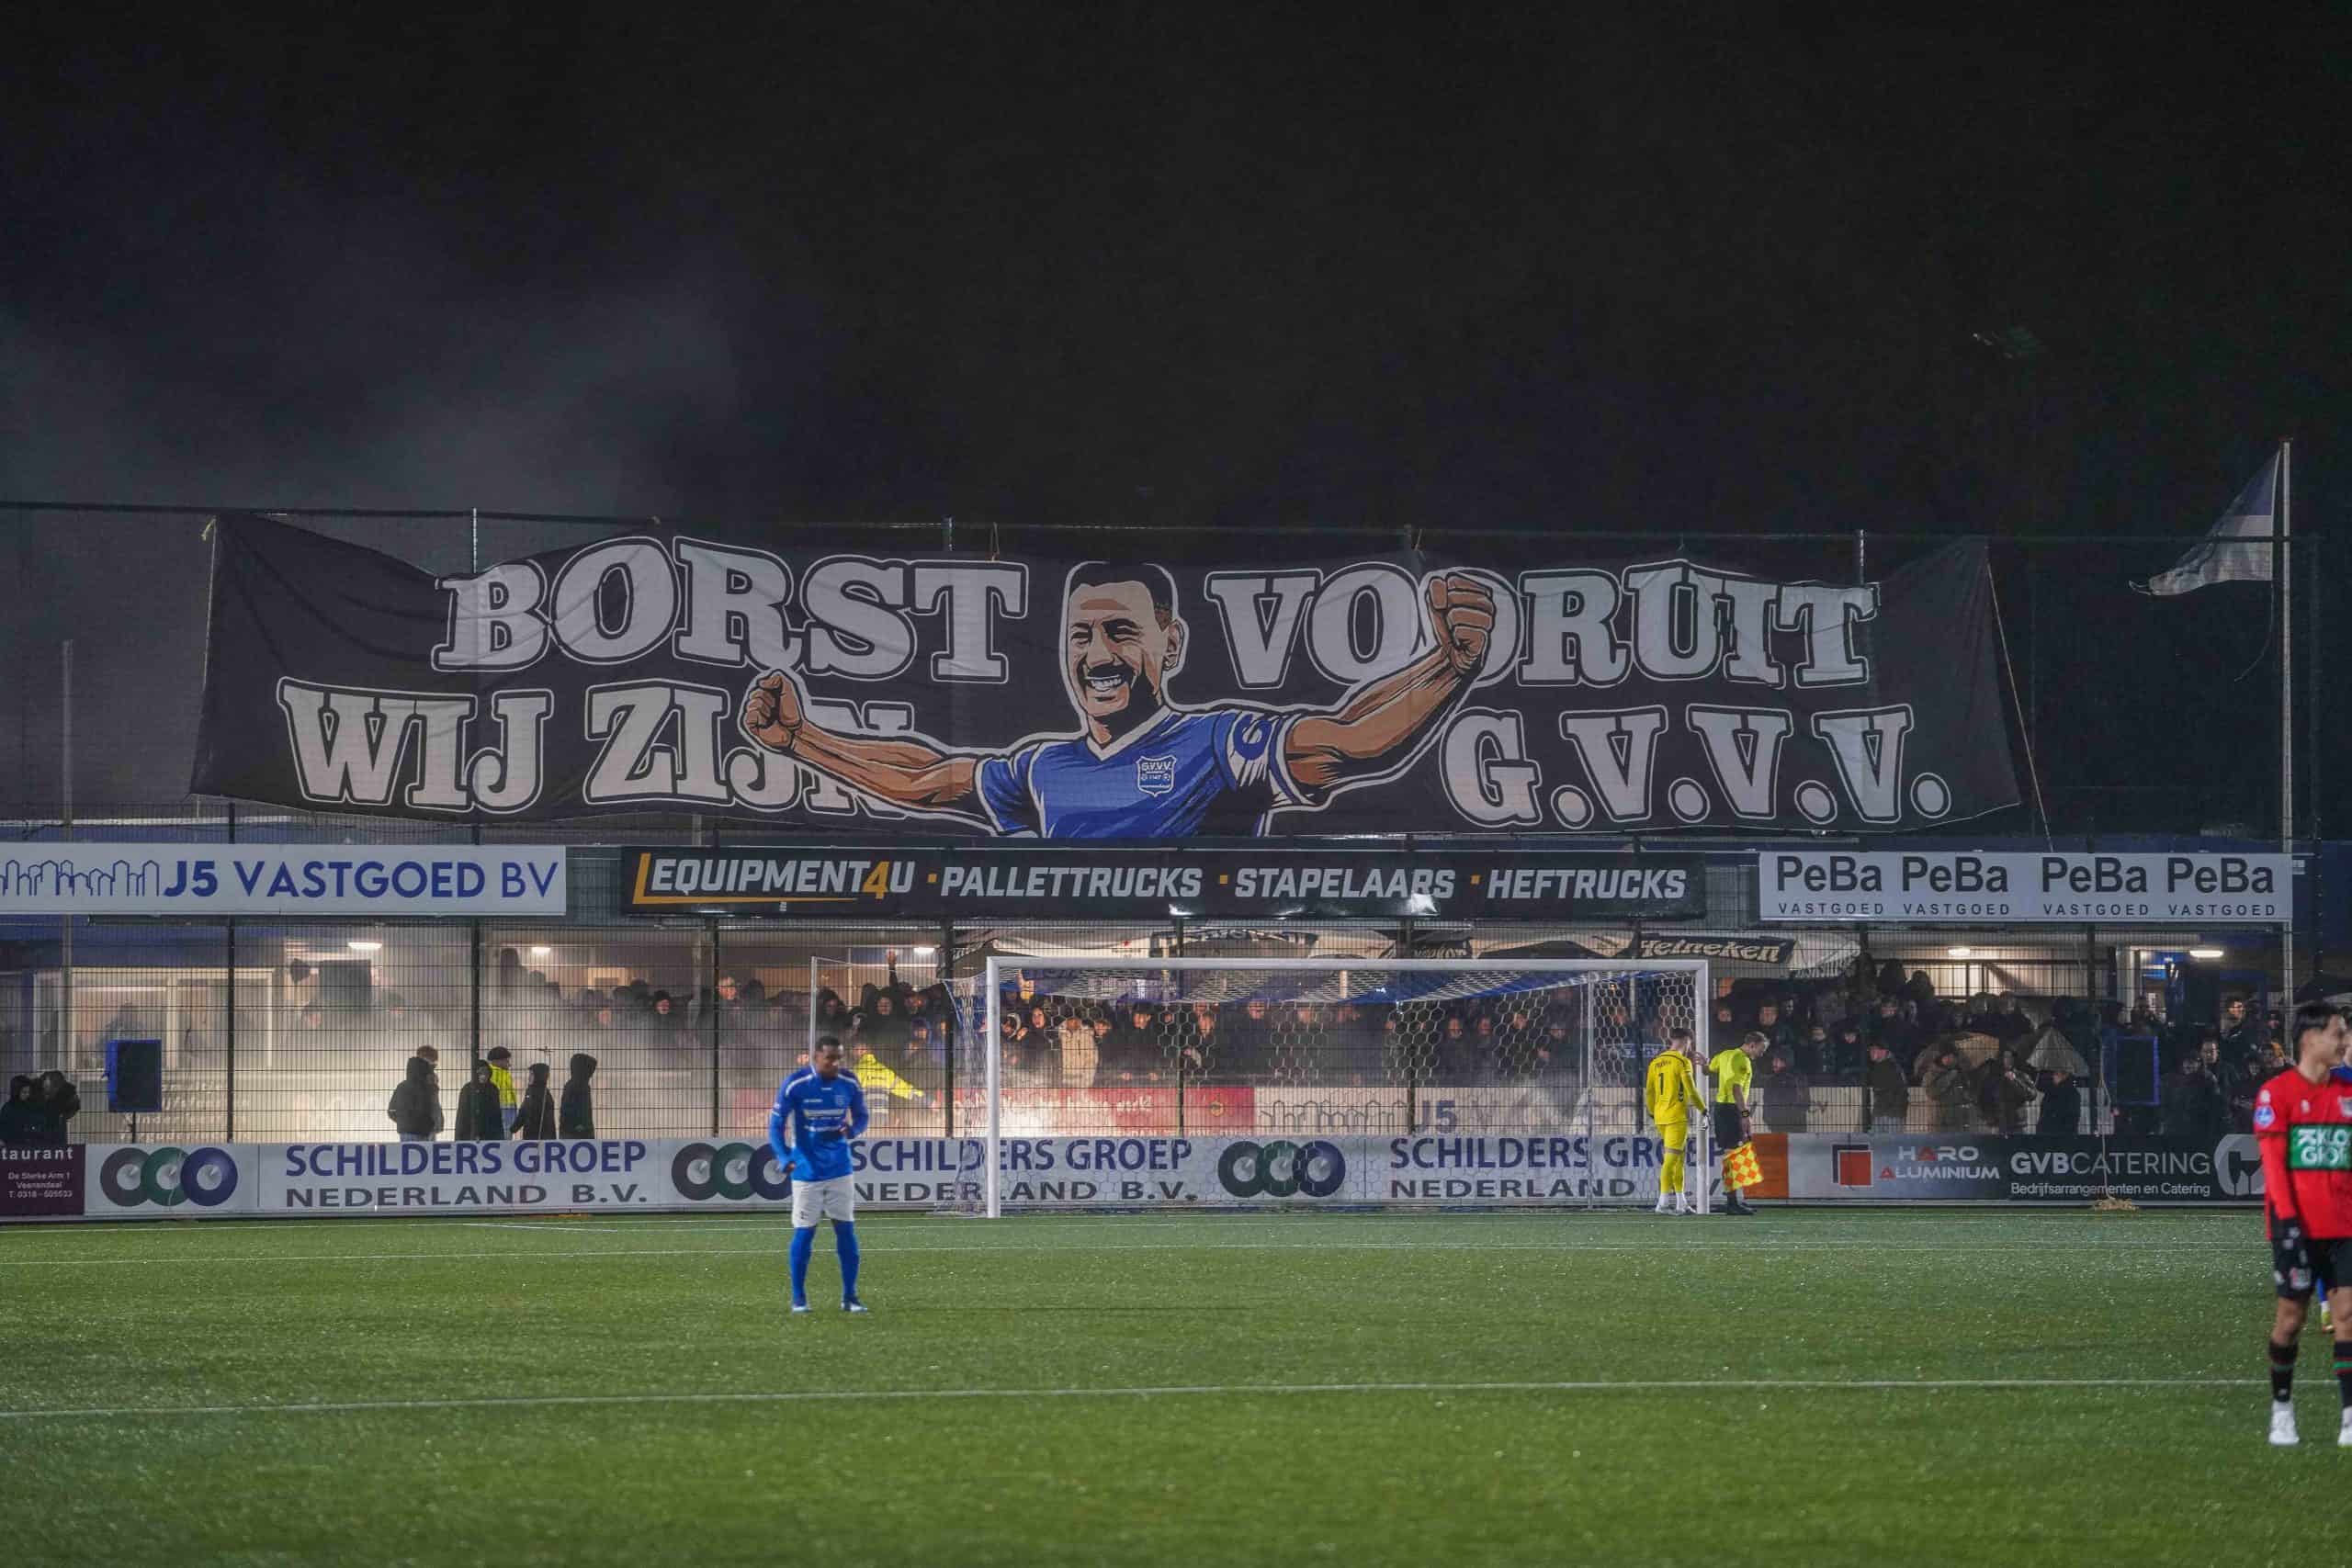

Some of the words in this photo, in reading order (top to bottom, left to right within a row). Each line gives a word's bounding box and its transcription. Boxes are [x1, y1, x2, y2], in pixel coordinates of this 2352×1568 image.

[431, 536, 1029, 684] BORST
[277, 676, 553, 812] WIJ
[1440, 705, 1951, 829] G.V.V.V.
[164, 861, 218, 897] J5
[234, 860, 486, 897] VASTGOED
[502, 862, 559, 897] BV
[650, 859, 916, 900] EQUIPMENT4U
[941, 866, 1203, 897] PALLETTRUCKS
[1234, 867, 1456, 898] STAPELAARS
[1487, 869, 1687, 899] HEFTRUCKS
[1776, 855, 1883, 893] PeBa
[1902, 855, 2009, 893] PeBa
[2041, 856, 2148, 894] PeBa
[2166, 857, 2275, 894] PeBa
[1778, 903, 1884, 915] VASTGOED
[1904, 903, 2010, 915] VASTGOED
[2043, 903, 2150, 916] VASTGOED
[2168, 904, 2276, 916] VASTGOED
[1641, 938, 1780, 963] Heineken
[1658, 1072, 1664, 1096] 1
[1, 1146, 74, 1160] taurant
[287, 1142, 501, 1177] SCHILDERS
[514, 1141, 646, 1173] GROEP
[1066, 1139, 1192, 1170] GROEP
[1390, 1137, 1589, 1168] SCHILDERS
[1603, 1136, 1725, 1168] GREP
[1898, 1146, 1979, 1162] HARO
[2010, 1151, 2211, 1176] GVBCATERING
[1879, 1166, 2000, 1179] ALUMINIUM
[287, 1184, 548, 1207] NEDERLAND
[572, 1184, 647, 1203] B.V.
[854, 1181, 1098, 1201] NEDERAND
[1121, 1181, 1198, 1200] B.V.
[1391, 1179, 1635, 1198] NEDERLAND
[2010, 1181, 2140, 1196] Bedrijfsarrangementen
[2144, 1185, 2158, 1193] en
[2161, 1181, 2211, 1196] Catering
